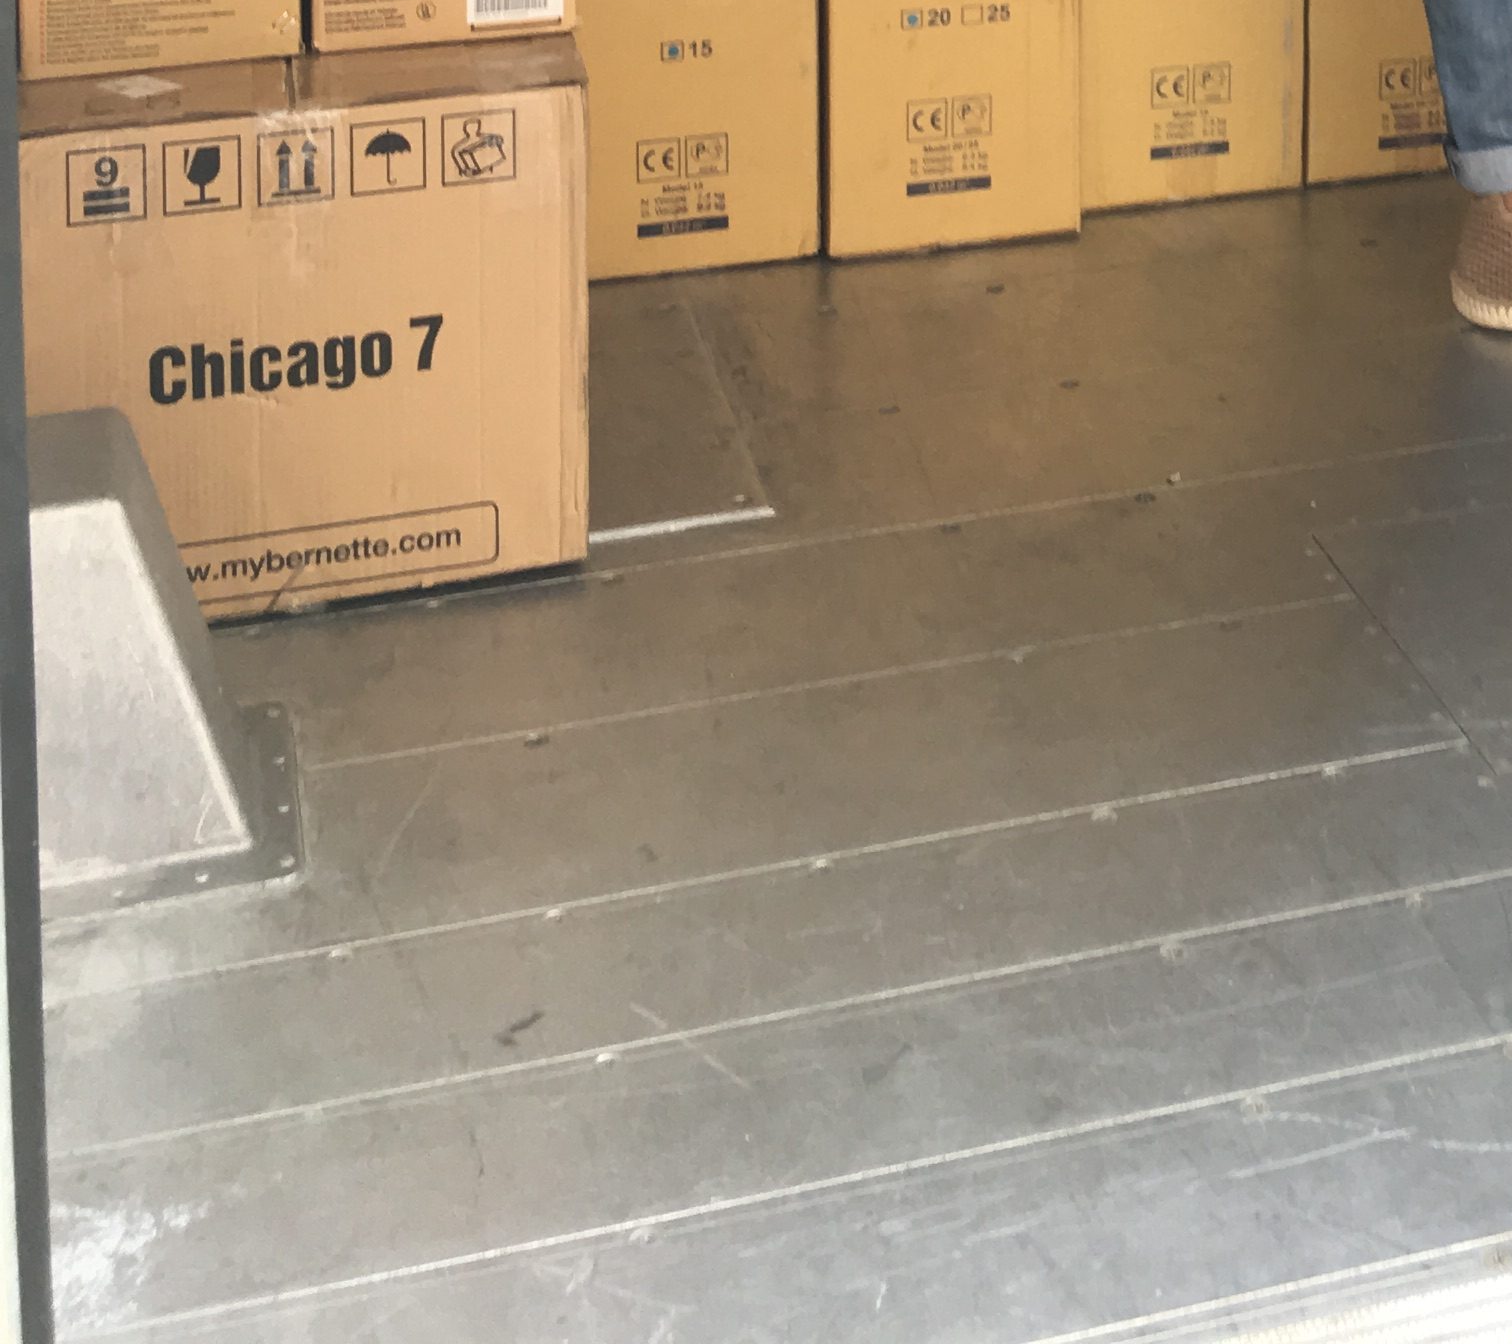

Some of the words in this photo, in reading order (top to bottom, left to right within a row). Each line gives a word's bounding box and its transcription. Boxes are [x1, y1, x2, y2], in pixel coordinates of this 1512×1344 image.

[927, 7, 952, 28] 20
[987, 4, 1011, 24] 25
[689, 39, 713, 59] 15
[93, 155, 119, 187] 9
[147, 328, 394, 407] Chicago
[409, 313, 444, 372] 7
[185, 524, 463, 585] w.mybernette.com
